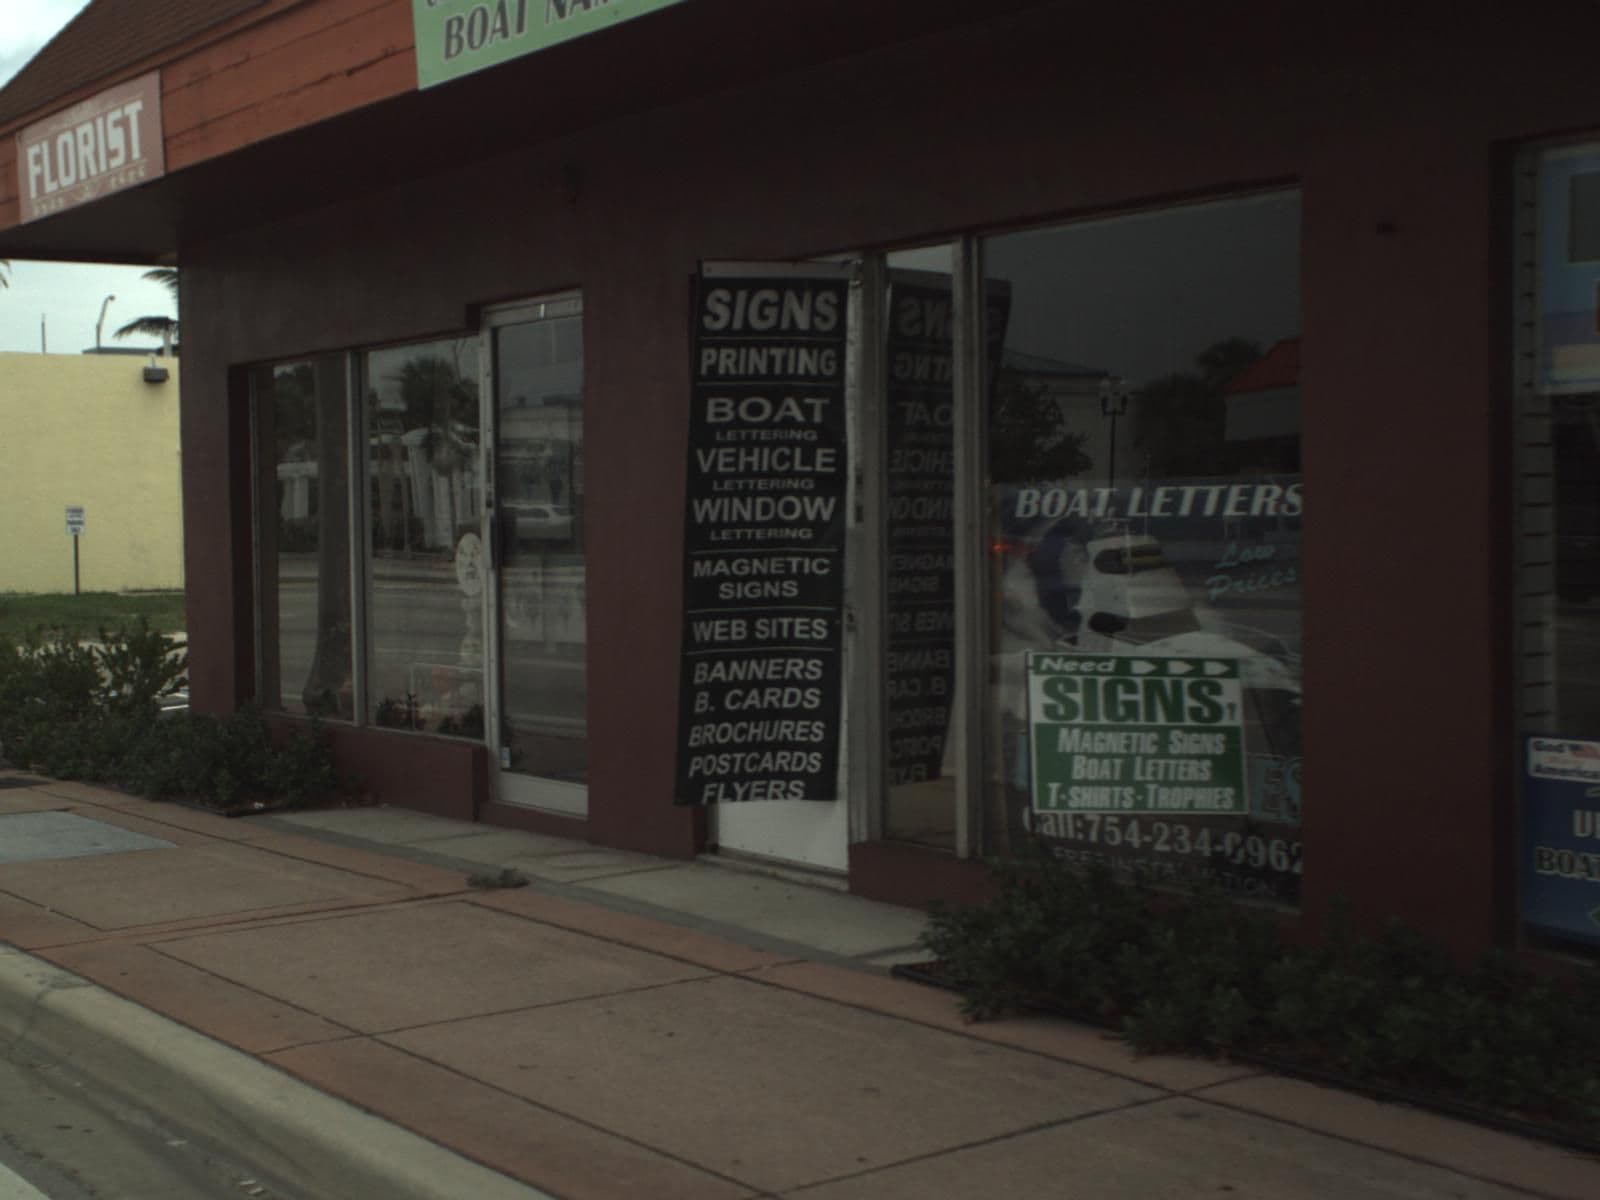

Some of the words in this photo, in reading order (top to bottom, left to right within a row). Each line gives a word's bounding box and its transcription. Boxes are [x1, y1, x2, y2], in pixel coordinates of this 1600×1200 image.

[444, 0, 527, 60] BOAT
[27, 99, 143, 200] FLORIST
[703, 289, 838, 332] SIGNS
[701, 347, 838, 376] PRINTING
[705, 397, 831, 424] BOAT
[715, 429, 818, 442] LETTERING
[696, 448, 837, 474] VEHICLE
[712, 478, 815, 492] LETTERING
[692, 496, 837, 524] WINDOW
[1015, 487, 1118, 518] BOAT
[1127, 483, 1303, 517] LETTERS
[709, 527, 813, 542] LETTERING
[692, 557, 832, 577] MAGNETIC
[718, 580, 799, 600] SIGNS
[692, 618, 747, 643] WEB
[754, 617, 828, 641] SITES
[693, 657, 824, 685] BANNERS
[1040, 656, 1118, 673] Need
[694, 691, 715, 714] B.
[724, 687, 822, 711] CARDS
[1042, 676, 1224, 724] SIGNS
[688, 720, 825, 748] BROCHURES
[1058, 727, 1159, 754] MAGNETIC
[1168, 729, 1226, 755] SIGNS
[689, 751, 823, 779] POSTCARDS
[1071, 754, 1125, 781] BOAT
[1133, 755, 1213, 782] LETTERS
[701, 779, 806, 805] FLYERS
